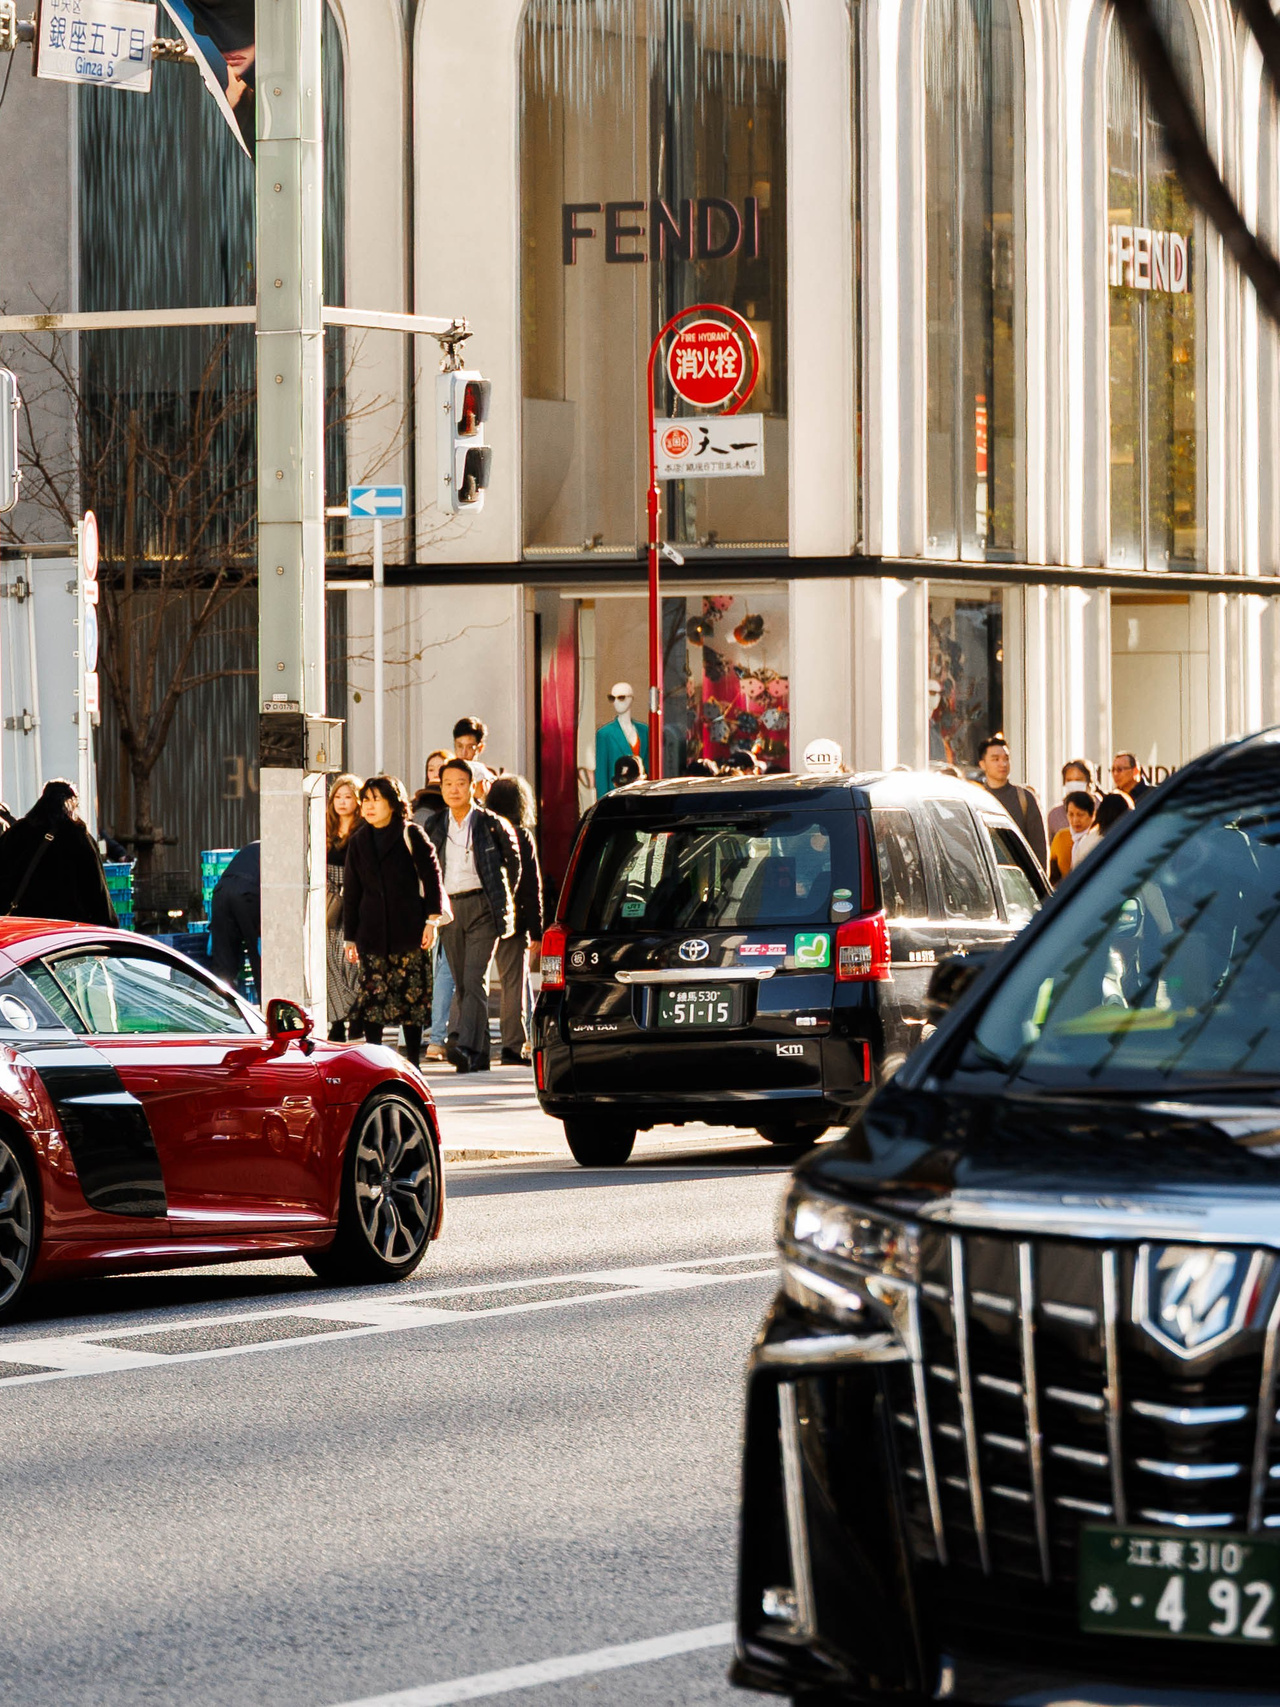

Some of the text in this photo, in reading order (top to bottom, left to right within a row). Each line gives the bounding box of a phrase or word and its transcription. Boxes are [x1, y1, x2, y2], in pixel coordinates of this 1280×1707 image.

[48, 15, 145, 61] 銀座五丁目
[75, 56, 114, 77] Ginza 5
[561, 195, 759, 266] FENDI
[680, 331, 730, 343] FIRE HYDRANT
[675, 345, 738, 380] 消火栓
[590, 952, 599, 964] 3
[662, 1002, 729, 1024] い 51-15
[776, 1043, 804, 1056] km
